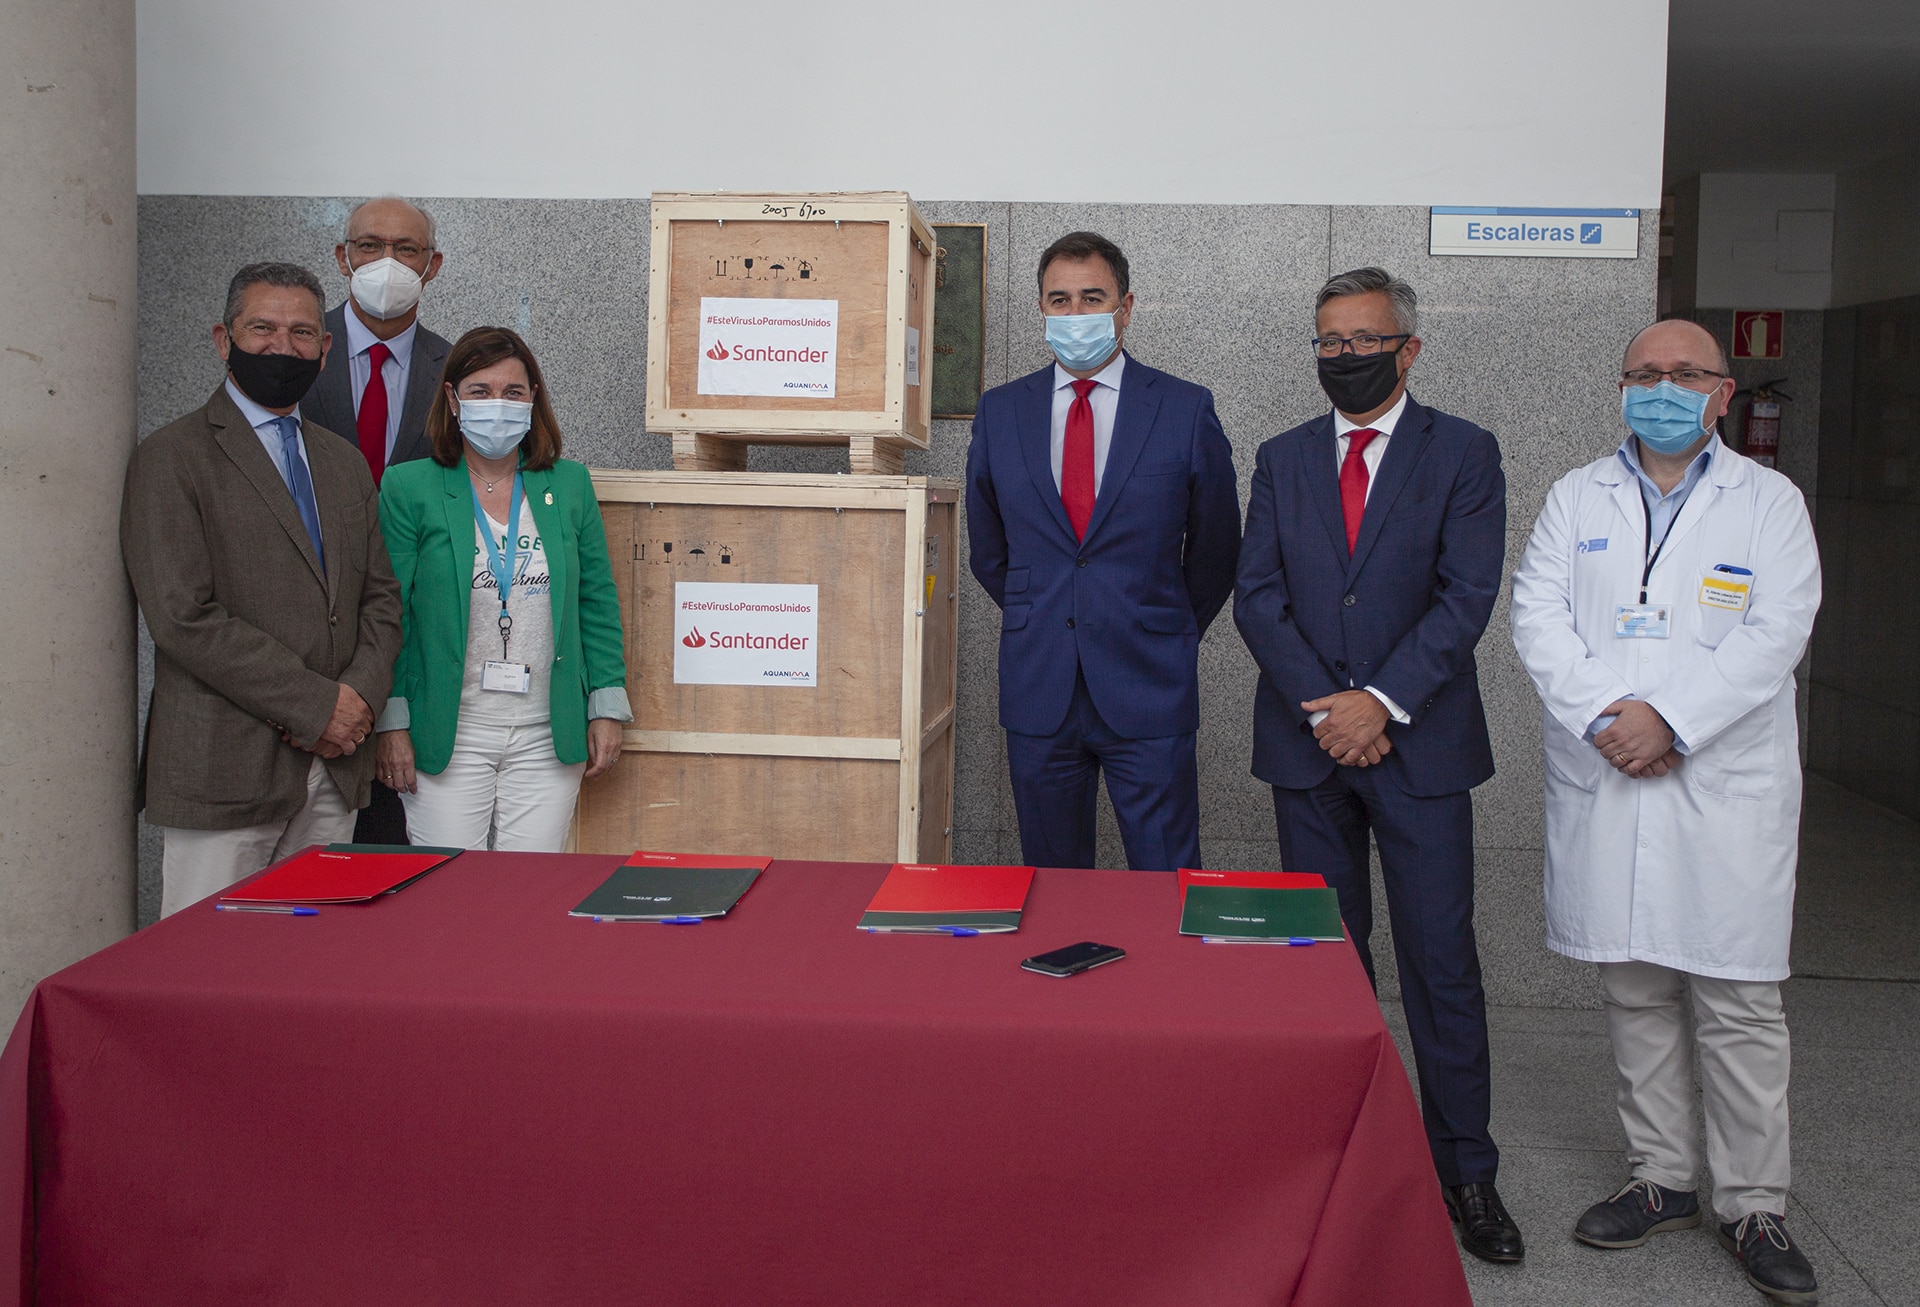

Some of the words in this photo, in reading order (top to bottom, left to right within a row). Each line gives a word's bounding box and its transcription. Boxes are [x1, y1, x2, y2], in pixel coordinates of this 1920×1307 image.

[1467, 222, 1575, 242] Escaleras
[707, 316, 831, 328] #EsteVirusLoParamosUnidos
[732, 344, 829, 363] Santander
[681, 601, 811, 613] #EsteVirusLoParamosUnidos
[709, 631, 809, 650] Santander
